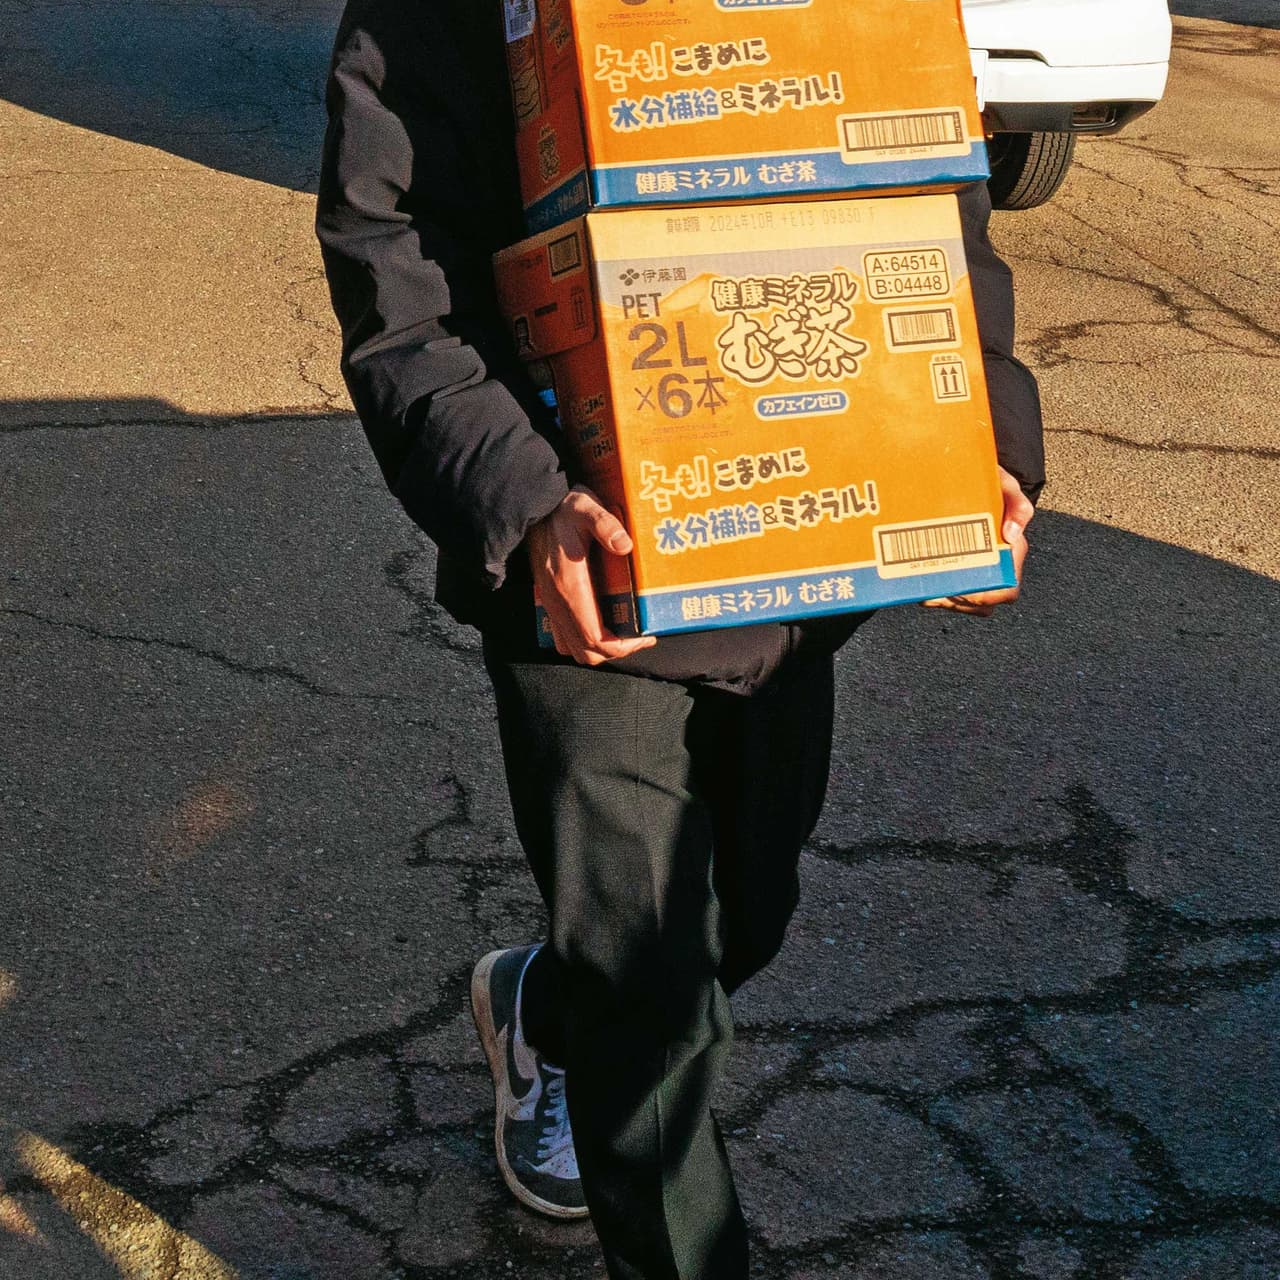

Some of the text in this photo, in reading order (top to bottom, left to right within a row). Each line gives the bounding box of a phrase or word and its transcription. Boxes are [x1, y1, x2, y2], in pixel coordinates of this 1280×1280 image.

[635, 160, 818, 194] 健康ミネラル むぎ茶
[641, 267, 688, 282] 伊藤園
[872, 254, 939, 273] A:64514
[711, 274, 857, 311] 健康ミネラル
[876, 275, 942, 295] B:04448
[621, 292, 662, 320] PET
[628, 321, 708, 370] 2L
[717, 300, 868, 383] むぎ茶
[634, 370, 729, 419] ×6本
[762, 394, 842, 414] カフェインゼロ
[681, 576, 856, 620] 健康ミネラル むぎ茶
